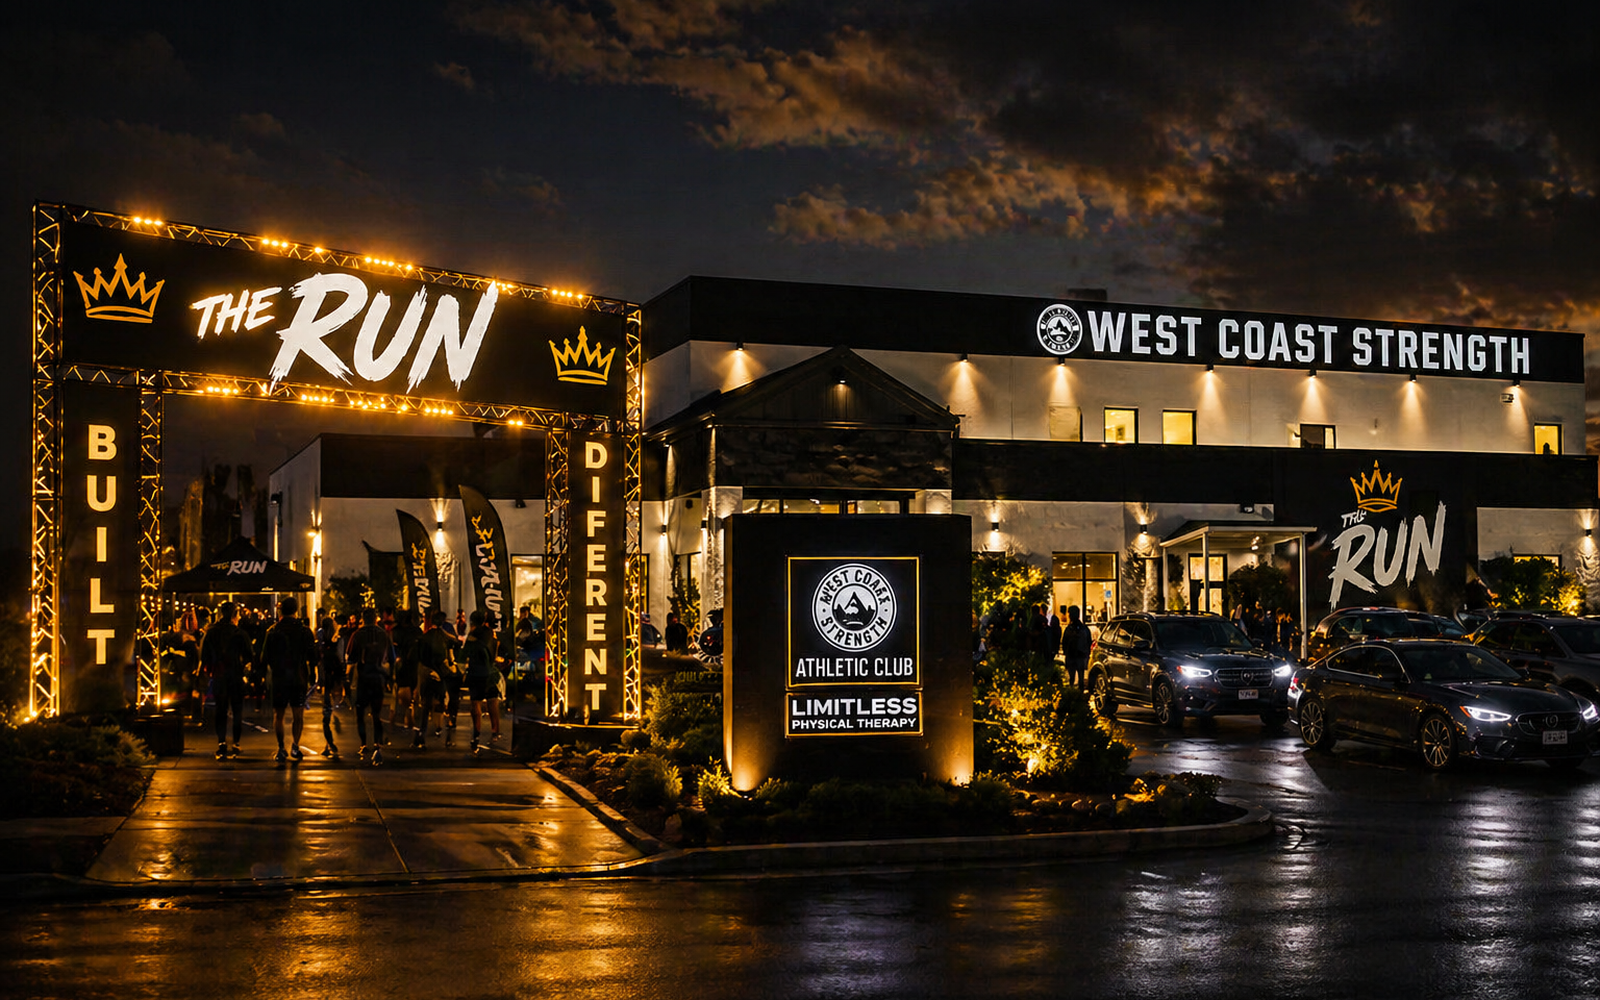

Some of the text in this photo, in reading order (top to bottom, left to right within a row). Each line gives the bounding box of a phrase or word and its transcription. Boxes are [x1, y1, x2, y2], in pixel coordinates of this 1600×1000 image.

[190, 271, 499, 397] THE RUN
[1087, 309, 1531, 374] WEST COAST STRENGTH
[86, 424, 118, 665] BUILT
[1327, 500, 1447, 613] RUN
[226, 560, 268, 576] RUN
[584, 441, 608, 711] DIFERENT
[819, 570, 849, 606] WEST
[820, 616, 888, 647] STRENGTH
[795, 657, 914, 678] ATHLETIC CLUB
[791, 717, 917, 730] PHYSICAL THERAPY
[792, 697, 918, 717] LIMITLESS
